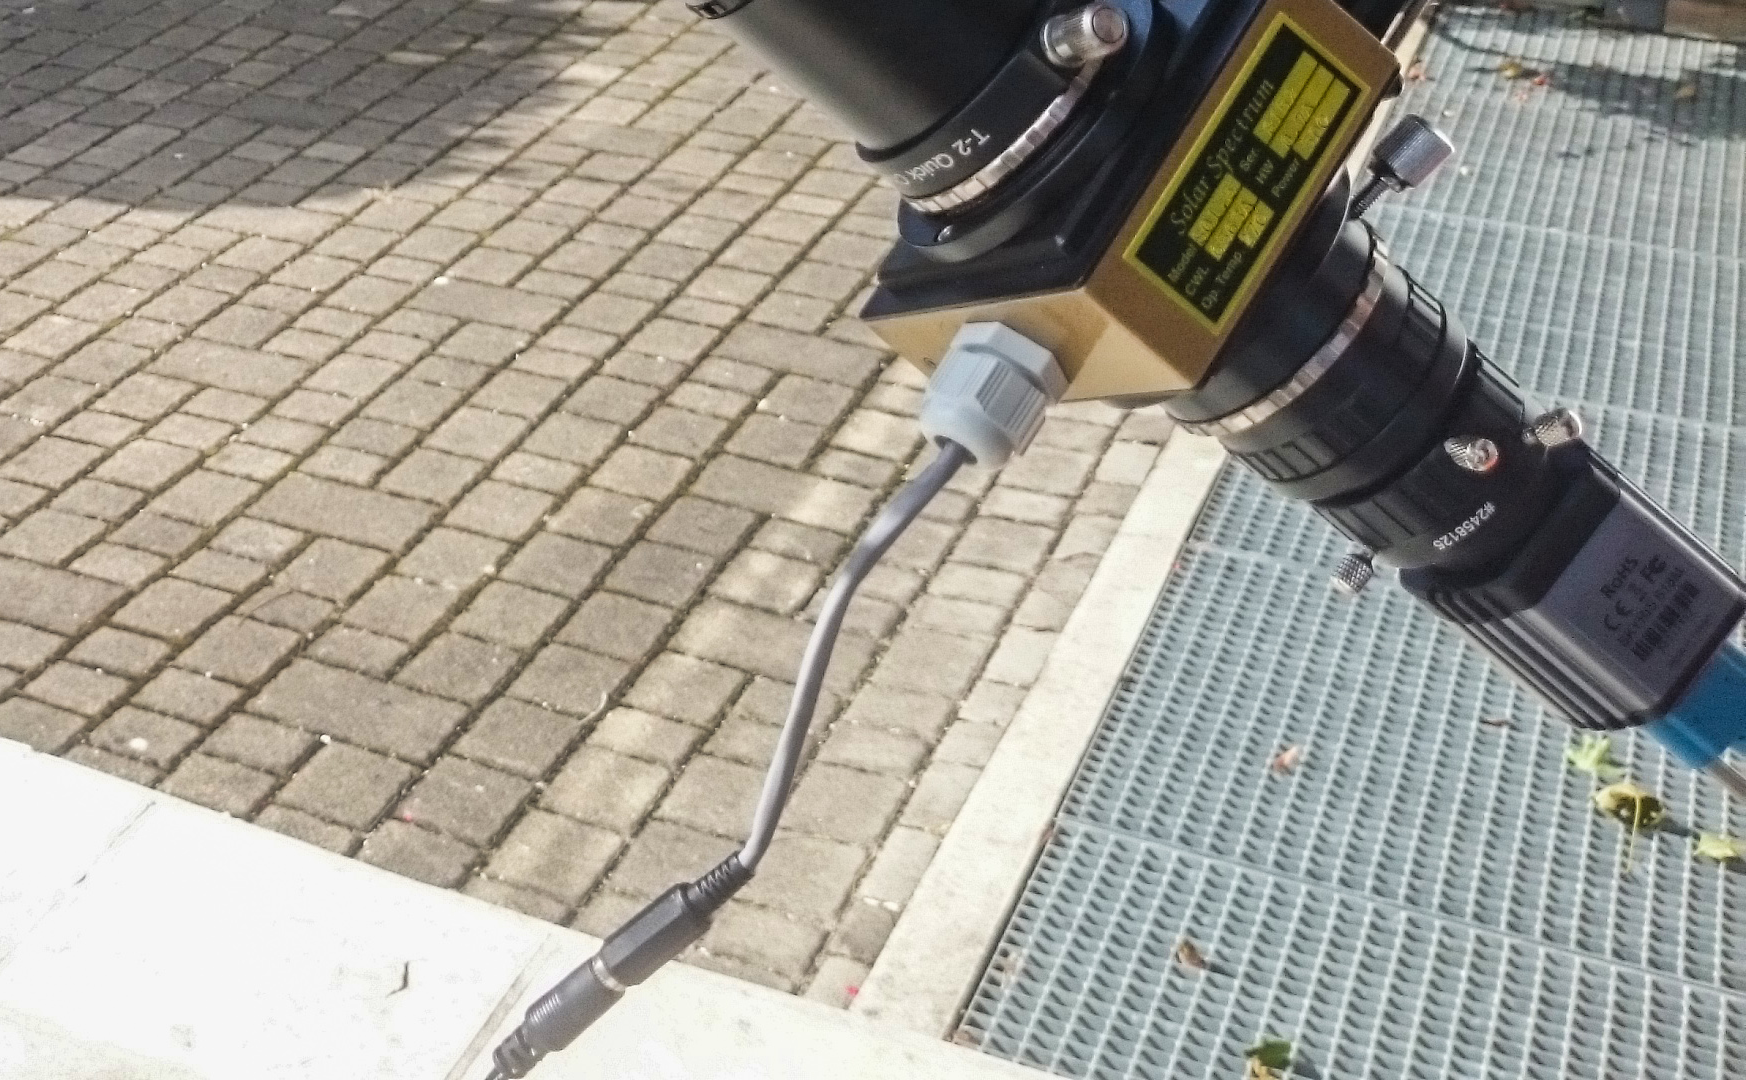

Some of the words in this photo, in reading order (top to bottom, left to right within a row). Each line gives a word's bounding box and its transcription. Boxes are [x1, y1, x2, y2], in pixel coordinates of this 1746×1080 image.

[951, 128, 991, 156] T-2
[1171, 174, 1210, 236] Solar
[1207, 77, 1275, 178] Spectrum
[905, 152, 954, 181] Quick
[1433, 501, 1495, 551] #2458125
